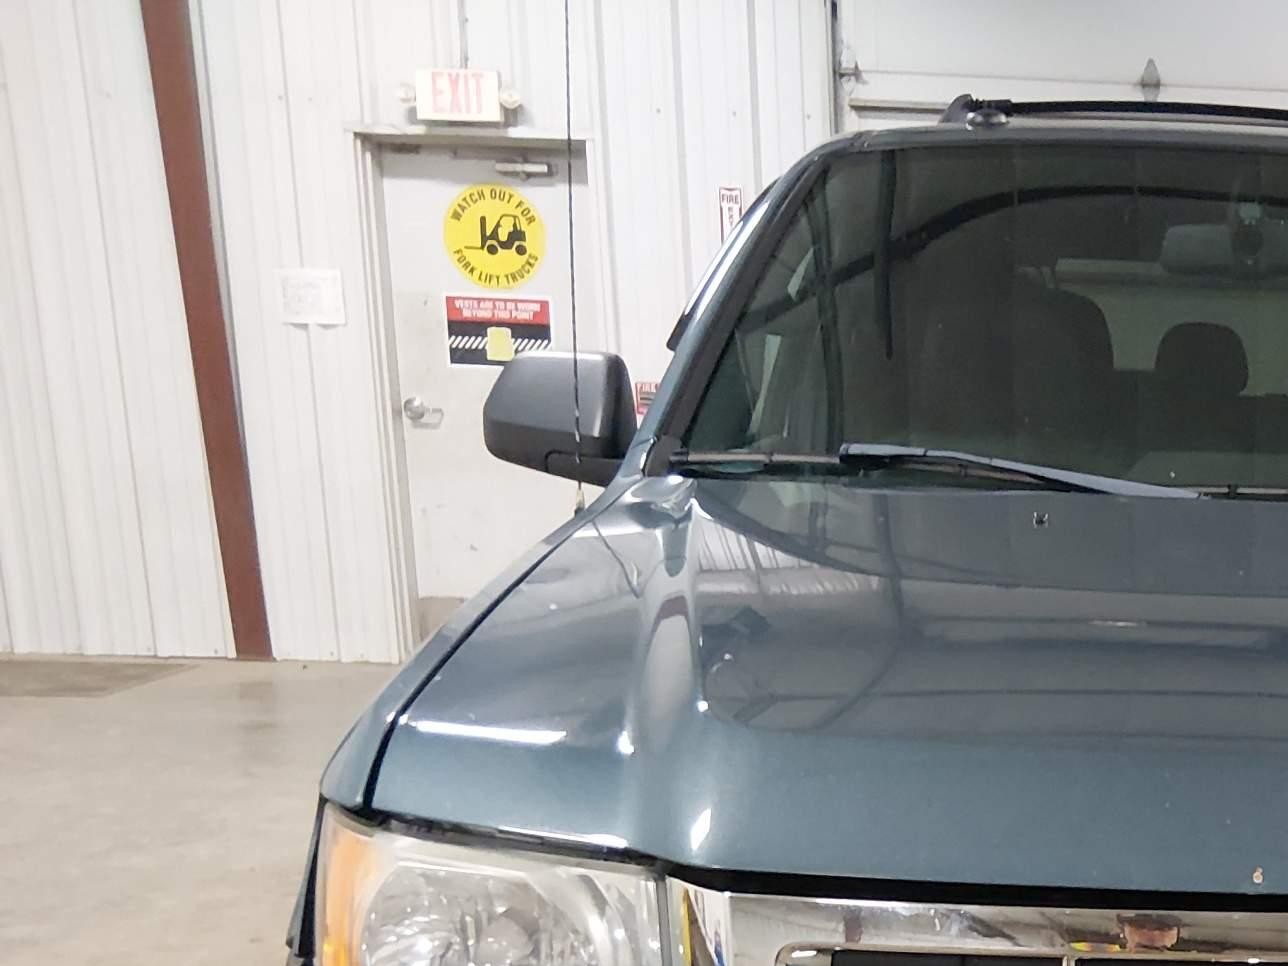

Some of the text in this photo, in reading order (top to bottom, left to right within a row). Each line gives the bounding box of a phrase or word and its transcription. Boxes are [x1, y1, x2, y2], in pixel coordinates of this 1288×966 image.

[431, 71, 484, 114] EXIT
[450, 187, 536, 226] WATCH OUT FOR
[721, 193, 740, 205] FIRE
[453, 248, 539, 286] FORK LIFT TRUCKS
